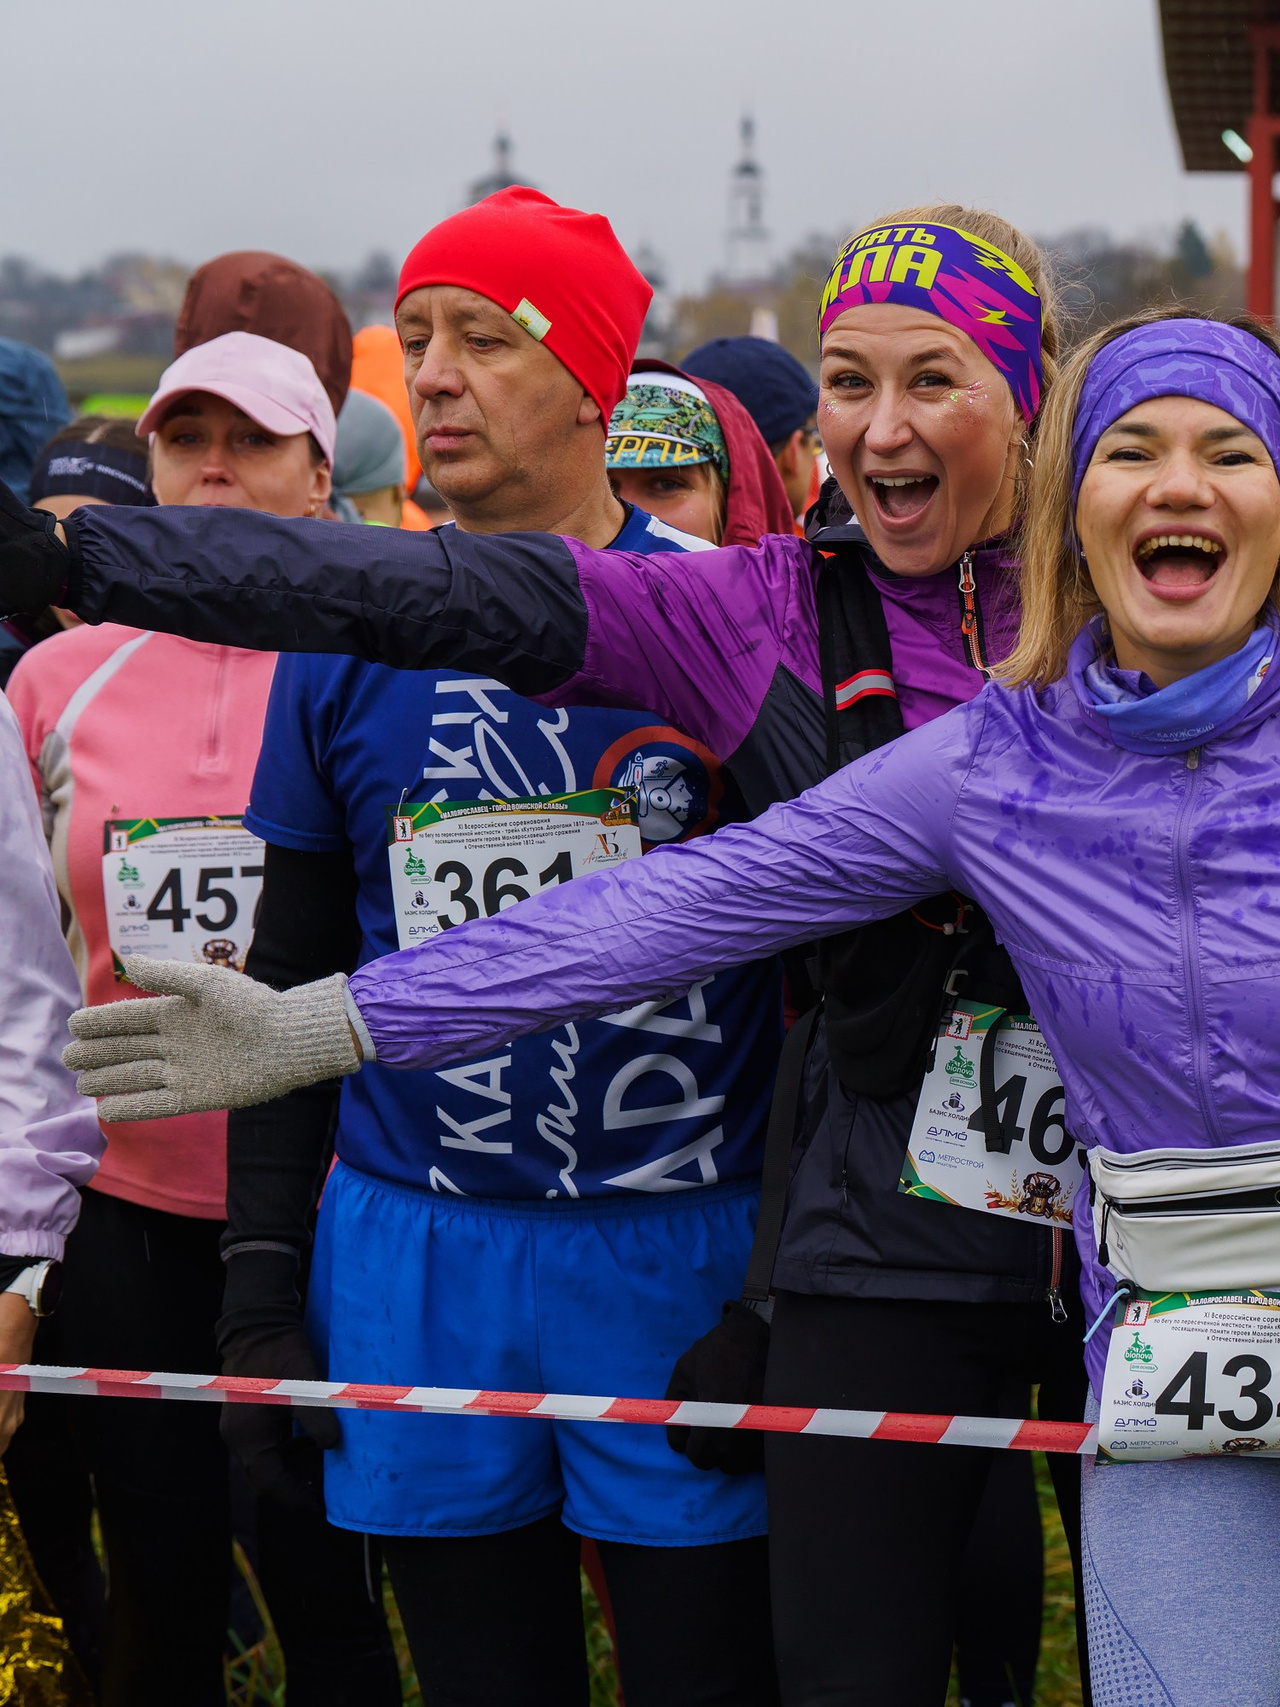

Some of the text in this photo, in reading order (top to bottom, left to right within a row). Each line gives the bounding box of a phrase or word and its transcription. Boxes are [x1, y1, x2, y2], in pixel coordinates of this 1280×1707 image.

[492, 804, 511, 812] ГОРОД
[511, 802, 542, 810] ВОИНСКОЙ
[464, 821, 507, 830] Всероссийские
[508, 818, 551, 827] соревнования
[546, 823, 572, 831] Дорогами
[502, 831, 553, 840] Малоярославецкого
[555, 828, 580, 836] сражения
[468, 841, 505, 850] Отечественной
[1005, 1041, 1043, 1055] пересеченной
[995, 1046, 1051, 1064] посвященные памяти
[946, 1064, 974, 1076] bionova
[929, 1108, 969, 1122] БАЗИС ХОЛДИ
[967, 1074, 1088, 1171] 46
[937, 1153, 984, 1169] МЕТРОСТРОЙ
[1187, 1295, 1242, 1306] «МАЛОЯРОСЛАВЕЦ
[1247, 1296, 1267, 1305] ГОРОД
[1211, 1312, 1260, 1322] Всероссийские
[1181, 1319, 1220, 1327] пересеченной
[1211, 1335, 1255, 1343] Отечественной
[1125, 1352, 1153, 1360] bionova
[1133, 1400, 1156, 1408] ХОЛДИ
